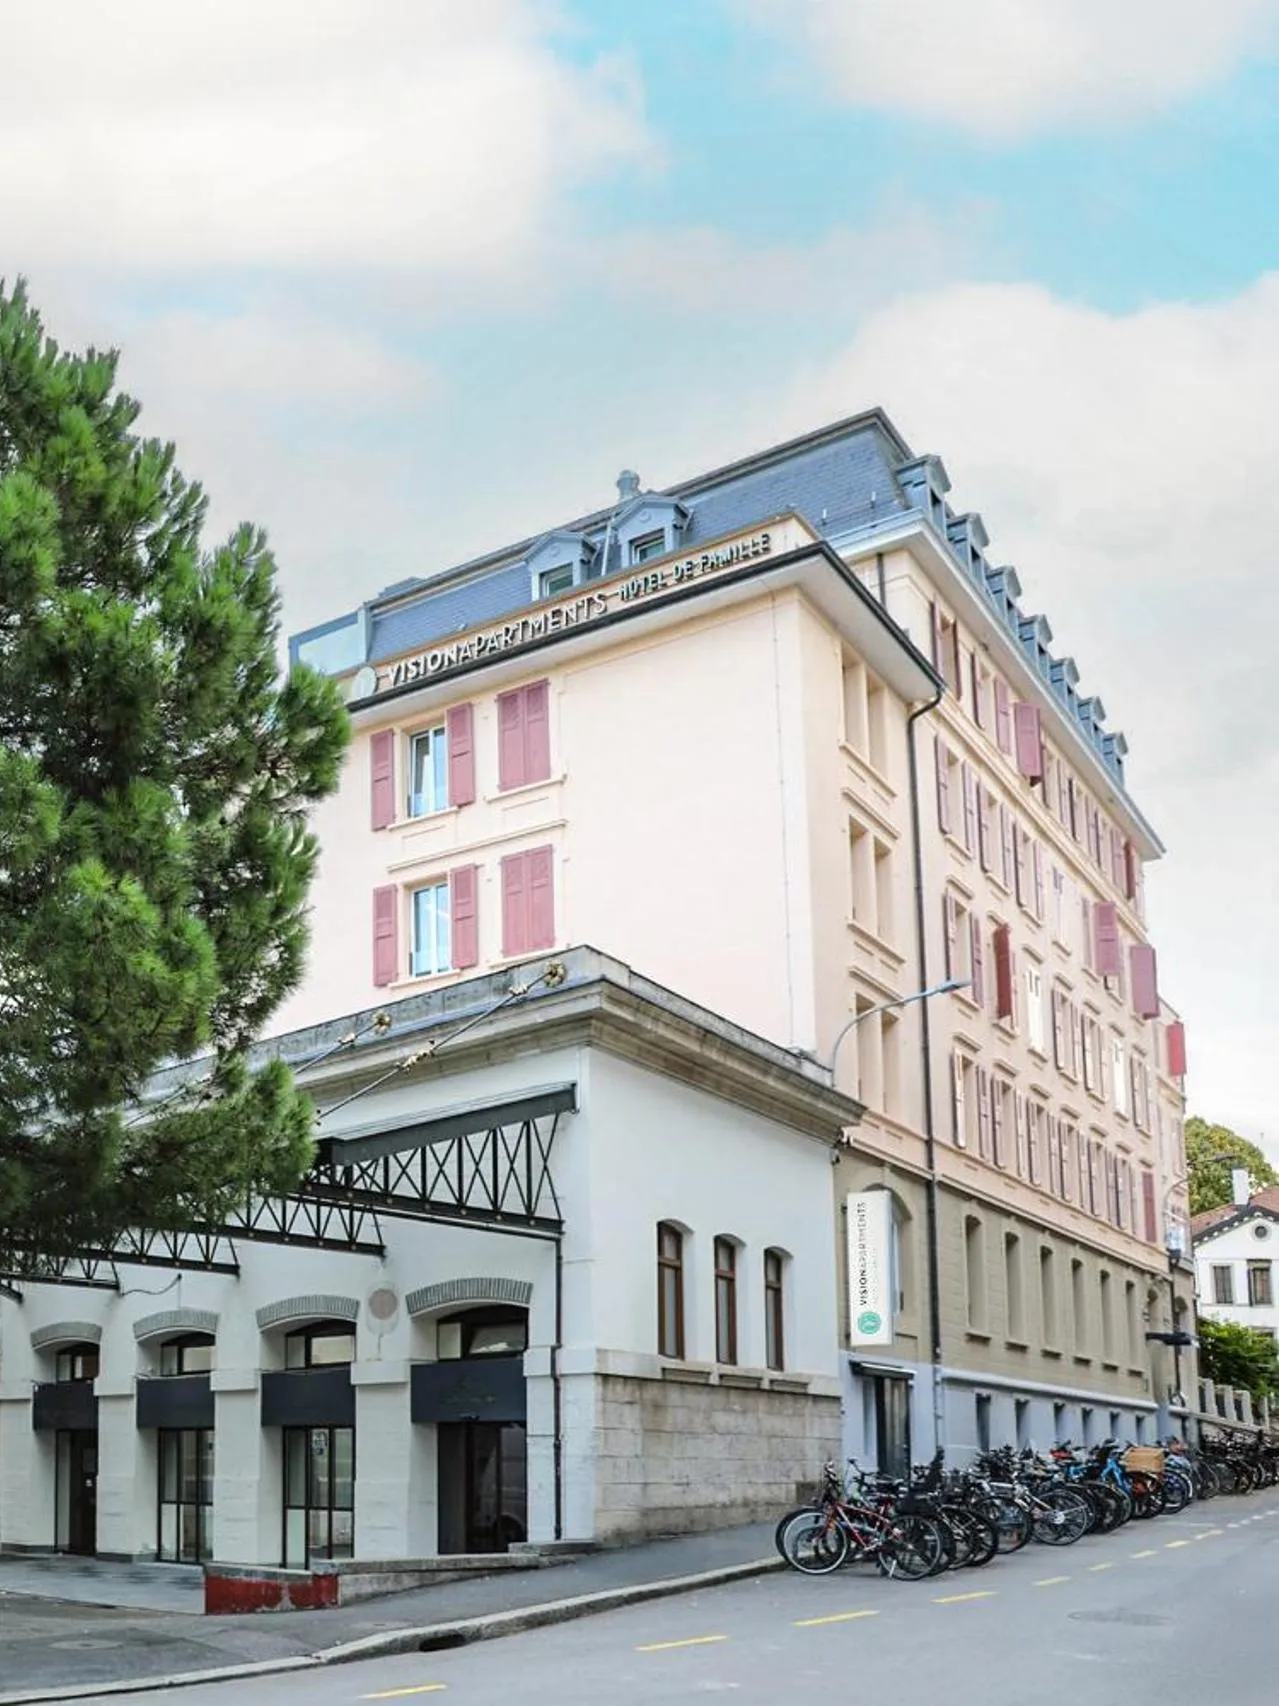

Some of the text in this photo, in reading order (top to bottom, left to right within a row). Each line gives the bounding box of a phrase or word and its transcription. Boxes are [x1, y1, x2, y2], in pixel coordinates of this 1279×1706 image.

[388, 591, 608, 685] VISIONAPARTMENTS
[673, 559, 696, 583] DE
[700, 533, 771, 573] FAMILLE
[856, 1201, 868, 1306] VISIONAPARTMENTS
